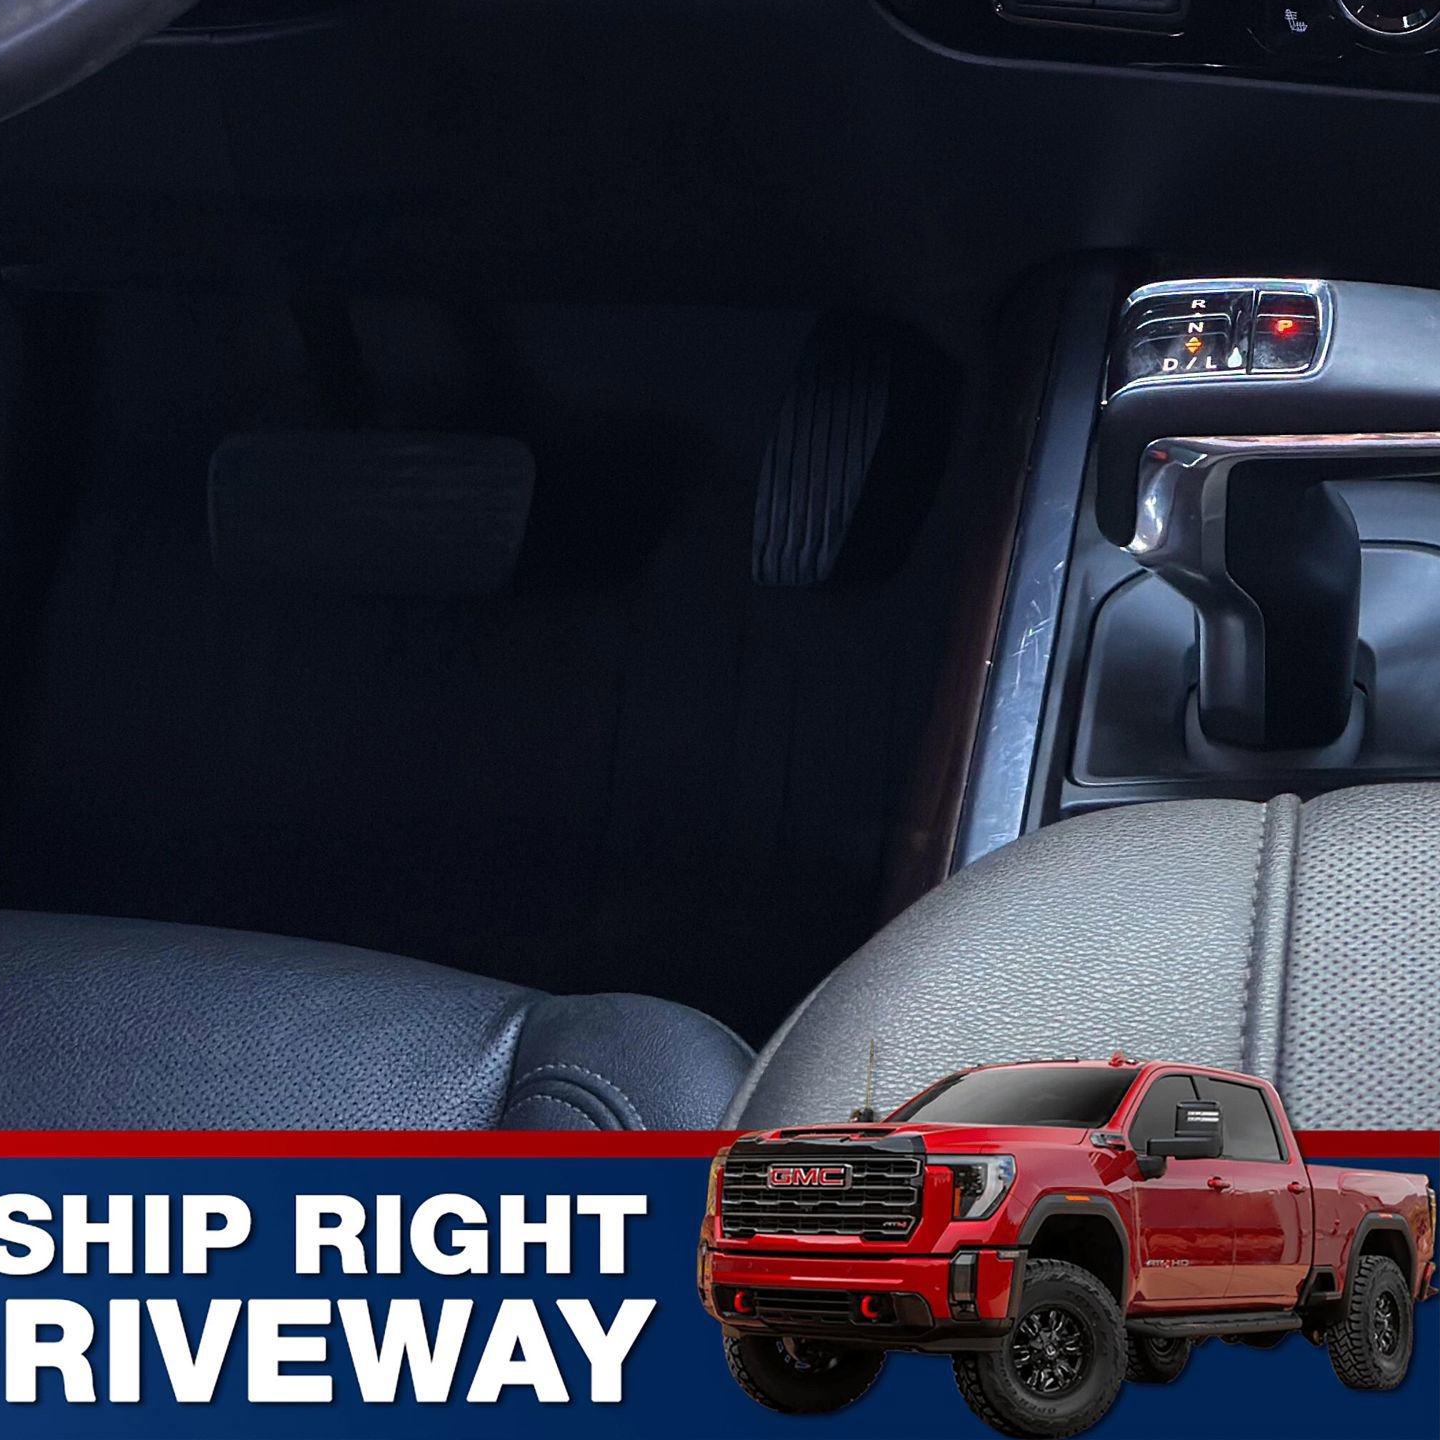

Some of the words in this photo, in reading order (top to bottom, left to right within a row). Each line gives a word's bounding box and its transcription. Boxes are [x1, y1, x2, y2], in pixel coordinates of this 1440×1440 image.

[1191, 299, 1207, 309] R
[1188, 321, 1205, 334] N
[1277, 319, 1293, 333] P
